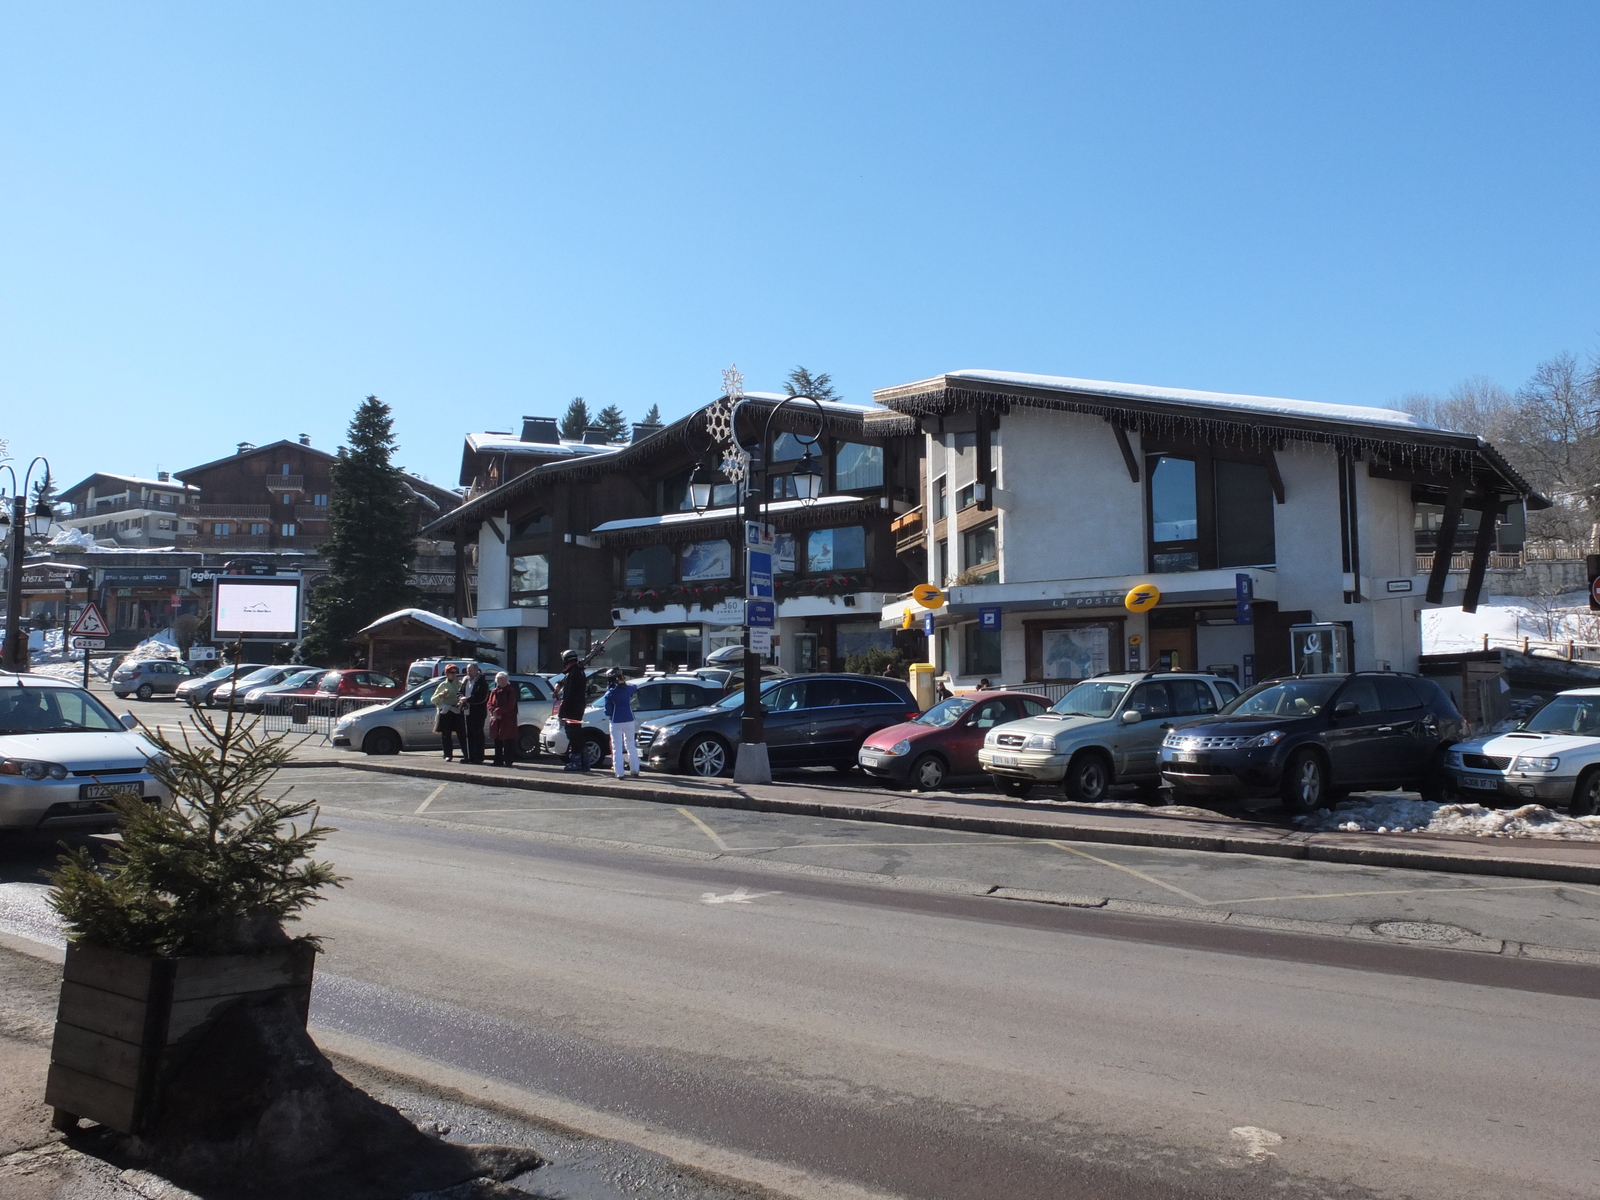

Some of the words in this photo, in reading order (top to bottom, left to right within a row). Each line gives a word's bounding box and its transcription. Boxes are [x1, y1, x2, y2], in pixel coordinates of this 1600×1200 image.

[723, 601, 738, 610] 360
[1052, 599, 1069, 607] LA
[1076, 596, 1120, 606] POSTE
